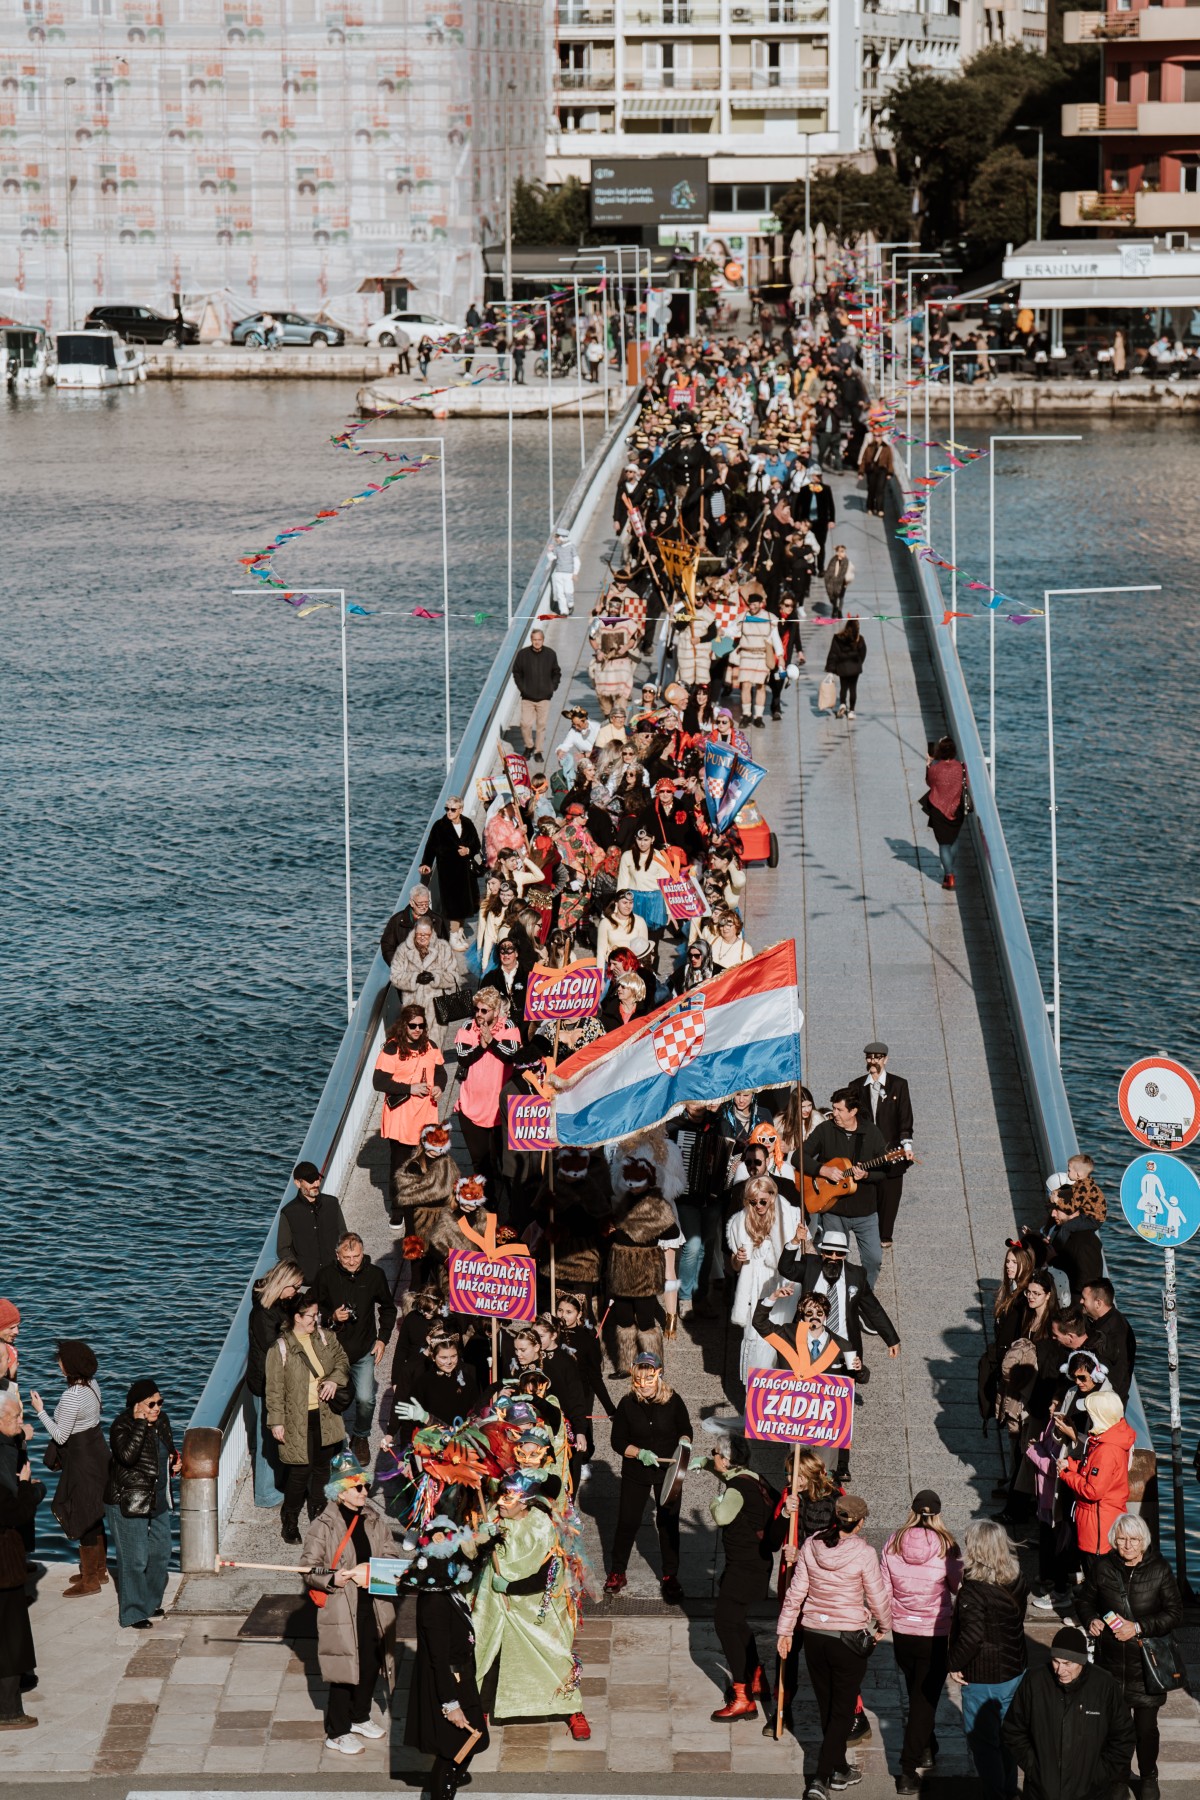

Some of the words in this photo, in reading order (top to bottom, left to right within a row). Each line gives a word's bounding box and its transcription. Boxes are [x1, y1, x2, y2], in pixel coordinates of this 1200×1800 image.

[706, 752, 757, 785] PUNTMIKA
[531, 1000, 545, 1012] SA
[547, 998, 594, 1011] STANOVA
[454, 1260, 530, 1281] BENKOVAČKE
[456, 1277, 528, 1298] MAŽORETKINJE
[475, 1296, 509, 1312] MAČKE
[752, 1377, 822, 1394] DRAGONBOAT
[823, 1384, 849, 1398] KLUB
[763, 1395, 836, 1421] ZADAR
[756, 1420, 805, 1436] VATRENI
[806, 1426, 840, 1441] ZMAJ
